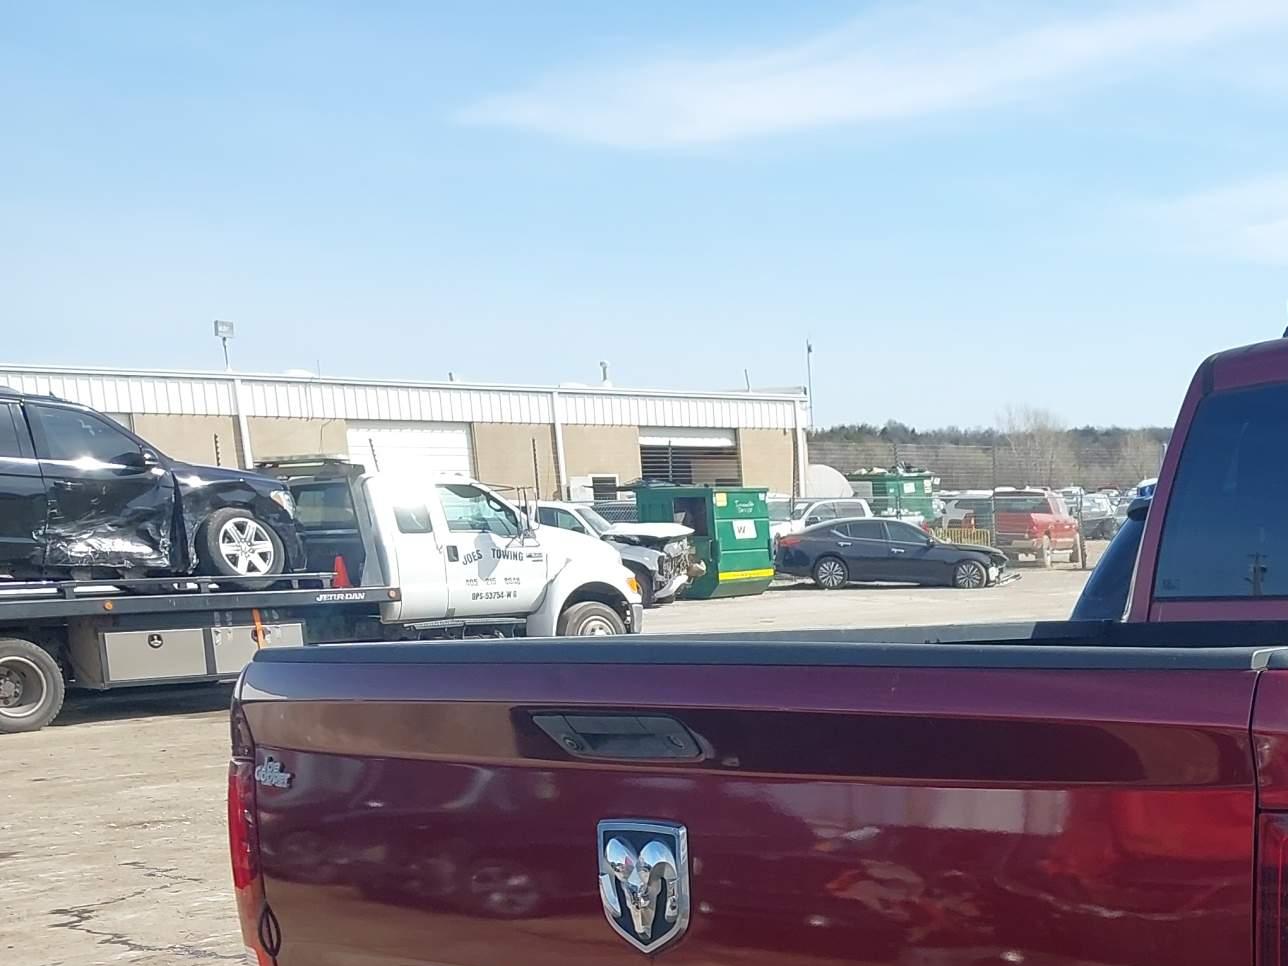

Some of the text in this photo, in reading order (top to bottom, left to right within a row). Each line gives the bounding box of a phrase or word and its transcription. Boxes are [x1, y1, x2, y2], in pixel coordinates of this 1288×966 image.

[462, 549, 483, 565] JOES
[491, 548, 523, 561] TOWING
[263, 756, 280, 772] Joe
[255, 764, 291, 788] Cooper
